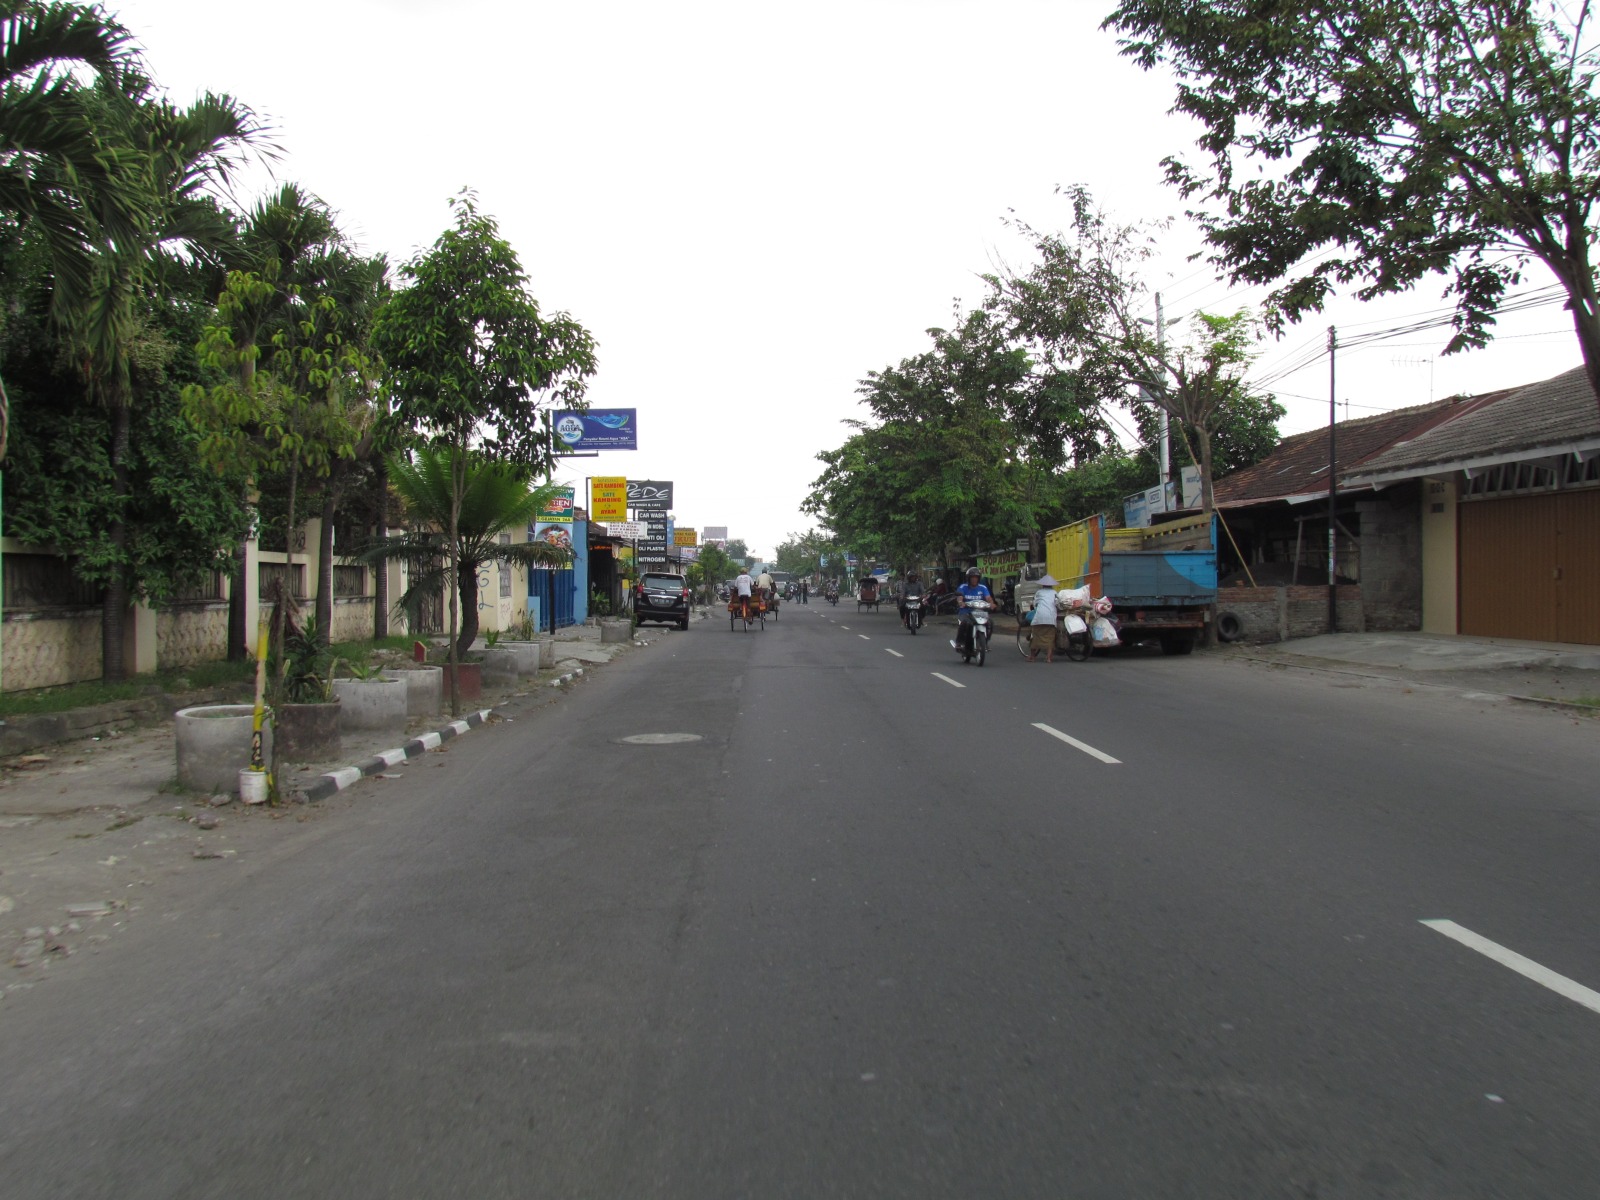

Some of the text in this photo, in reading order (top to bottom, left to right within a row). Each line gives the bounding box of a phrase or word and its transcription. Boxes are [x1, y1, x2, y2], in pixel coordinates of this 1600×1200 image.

[560, 424, 580, 432] AQUA
[983, 552, 1018, 565] SOP AYAM
